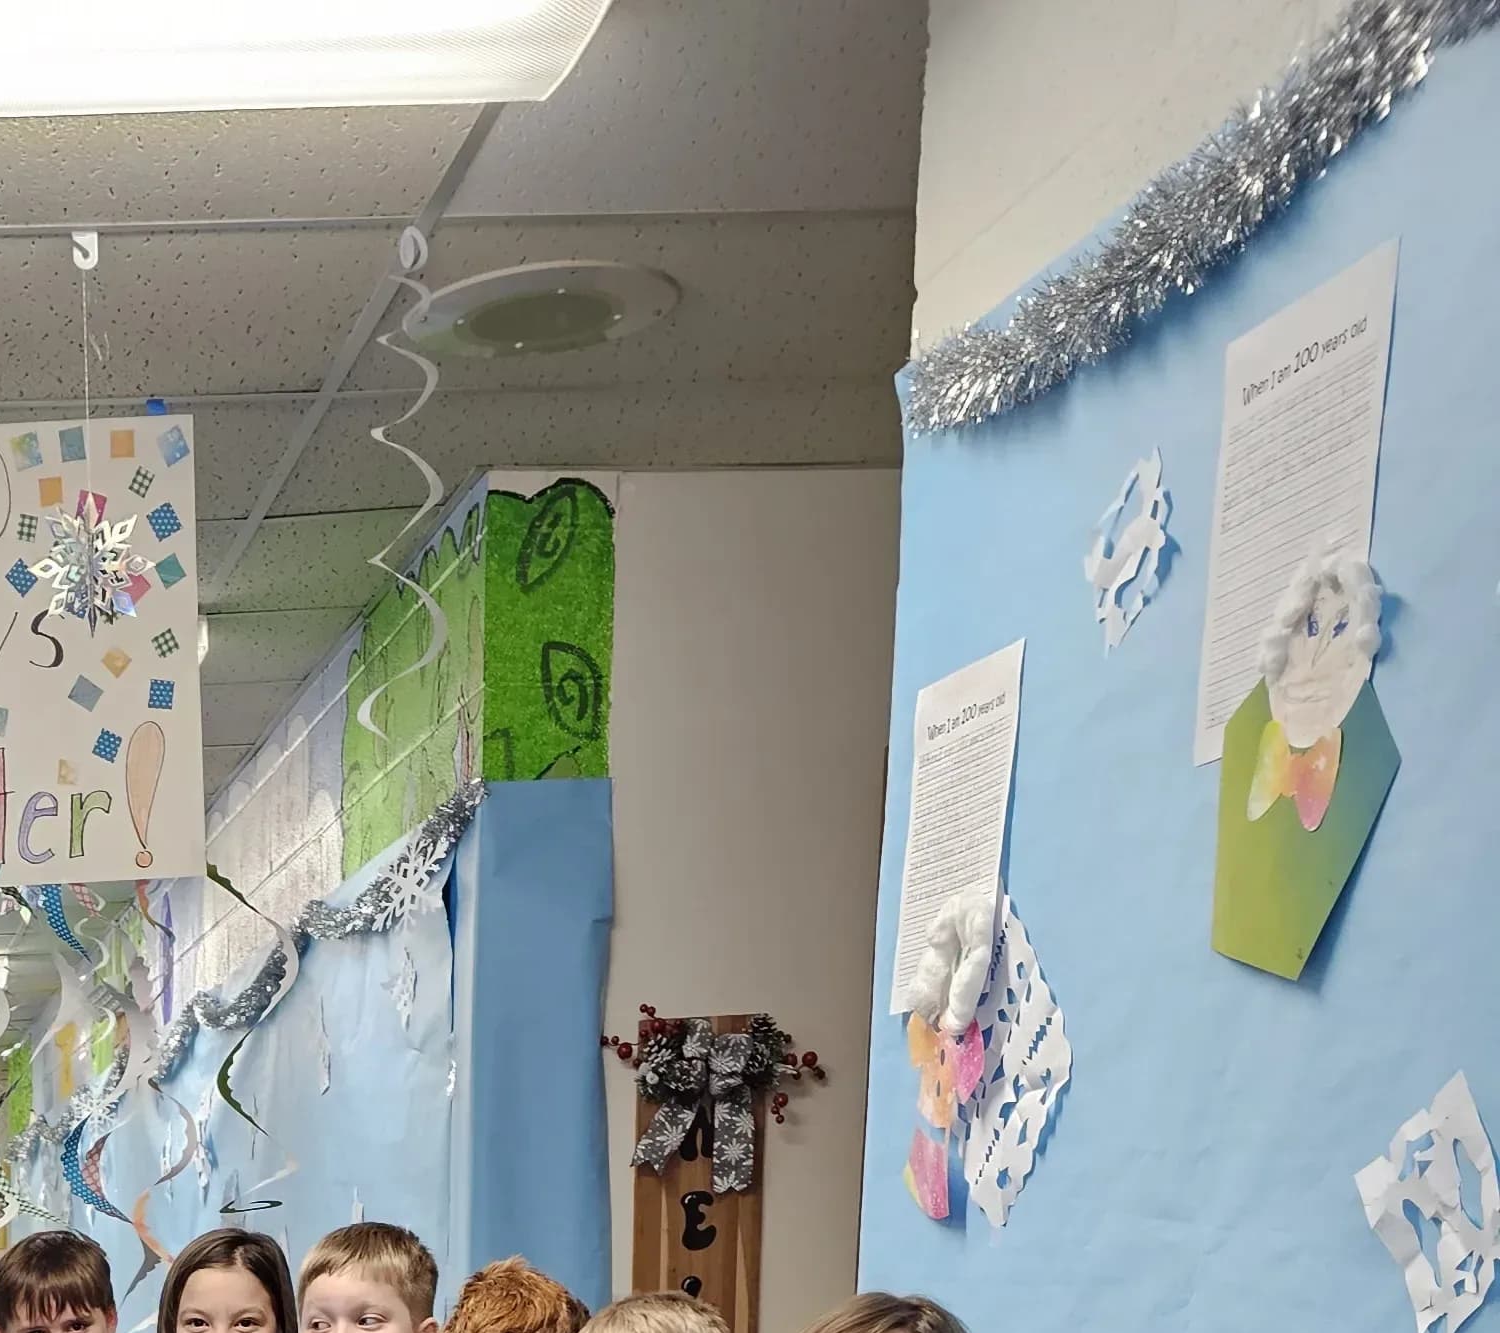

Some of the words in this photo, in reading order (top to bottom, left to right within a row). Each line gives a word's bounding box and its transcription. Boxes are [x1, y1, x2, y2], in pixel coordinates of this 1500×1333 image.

[1242, 379, 1269, 406] When
[1271, 370, 1277, 390] I
[1277, 364, 1291, 384] am
[1294, 341, 1319, 373] 100
[1320, 328, 1348, 360] years
[1350, 315, 1368, 338] old
[927, 723, 946, 740] When
[946, 718, 951, 734] I
[951, 716, 960, 730] am
[961, 703, 977, 724] 100
[978, 699, 996, 719] years
[995, 691, 1006, 707] old
